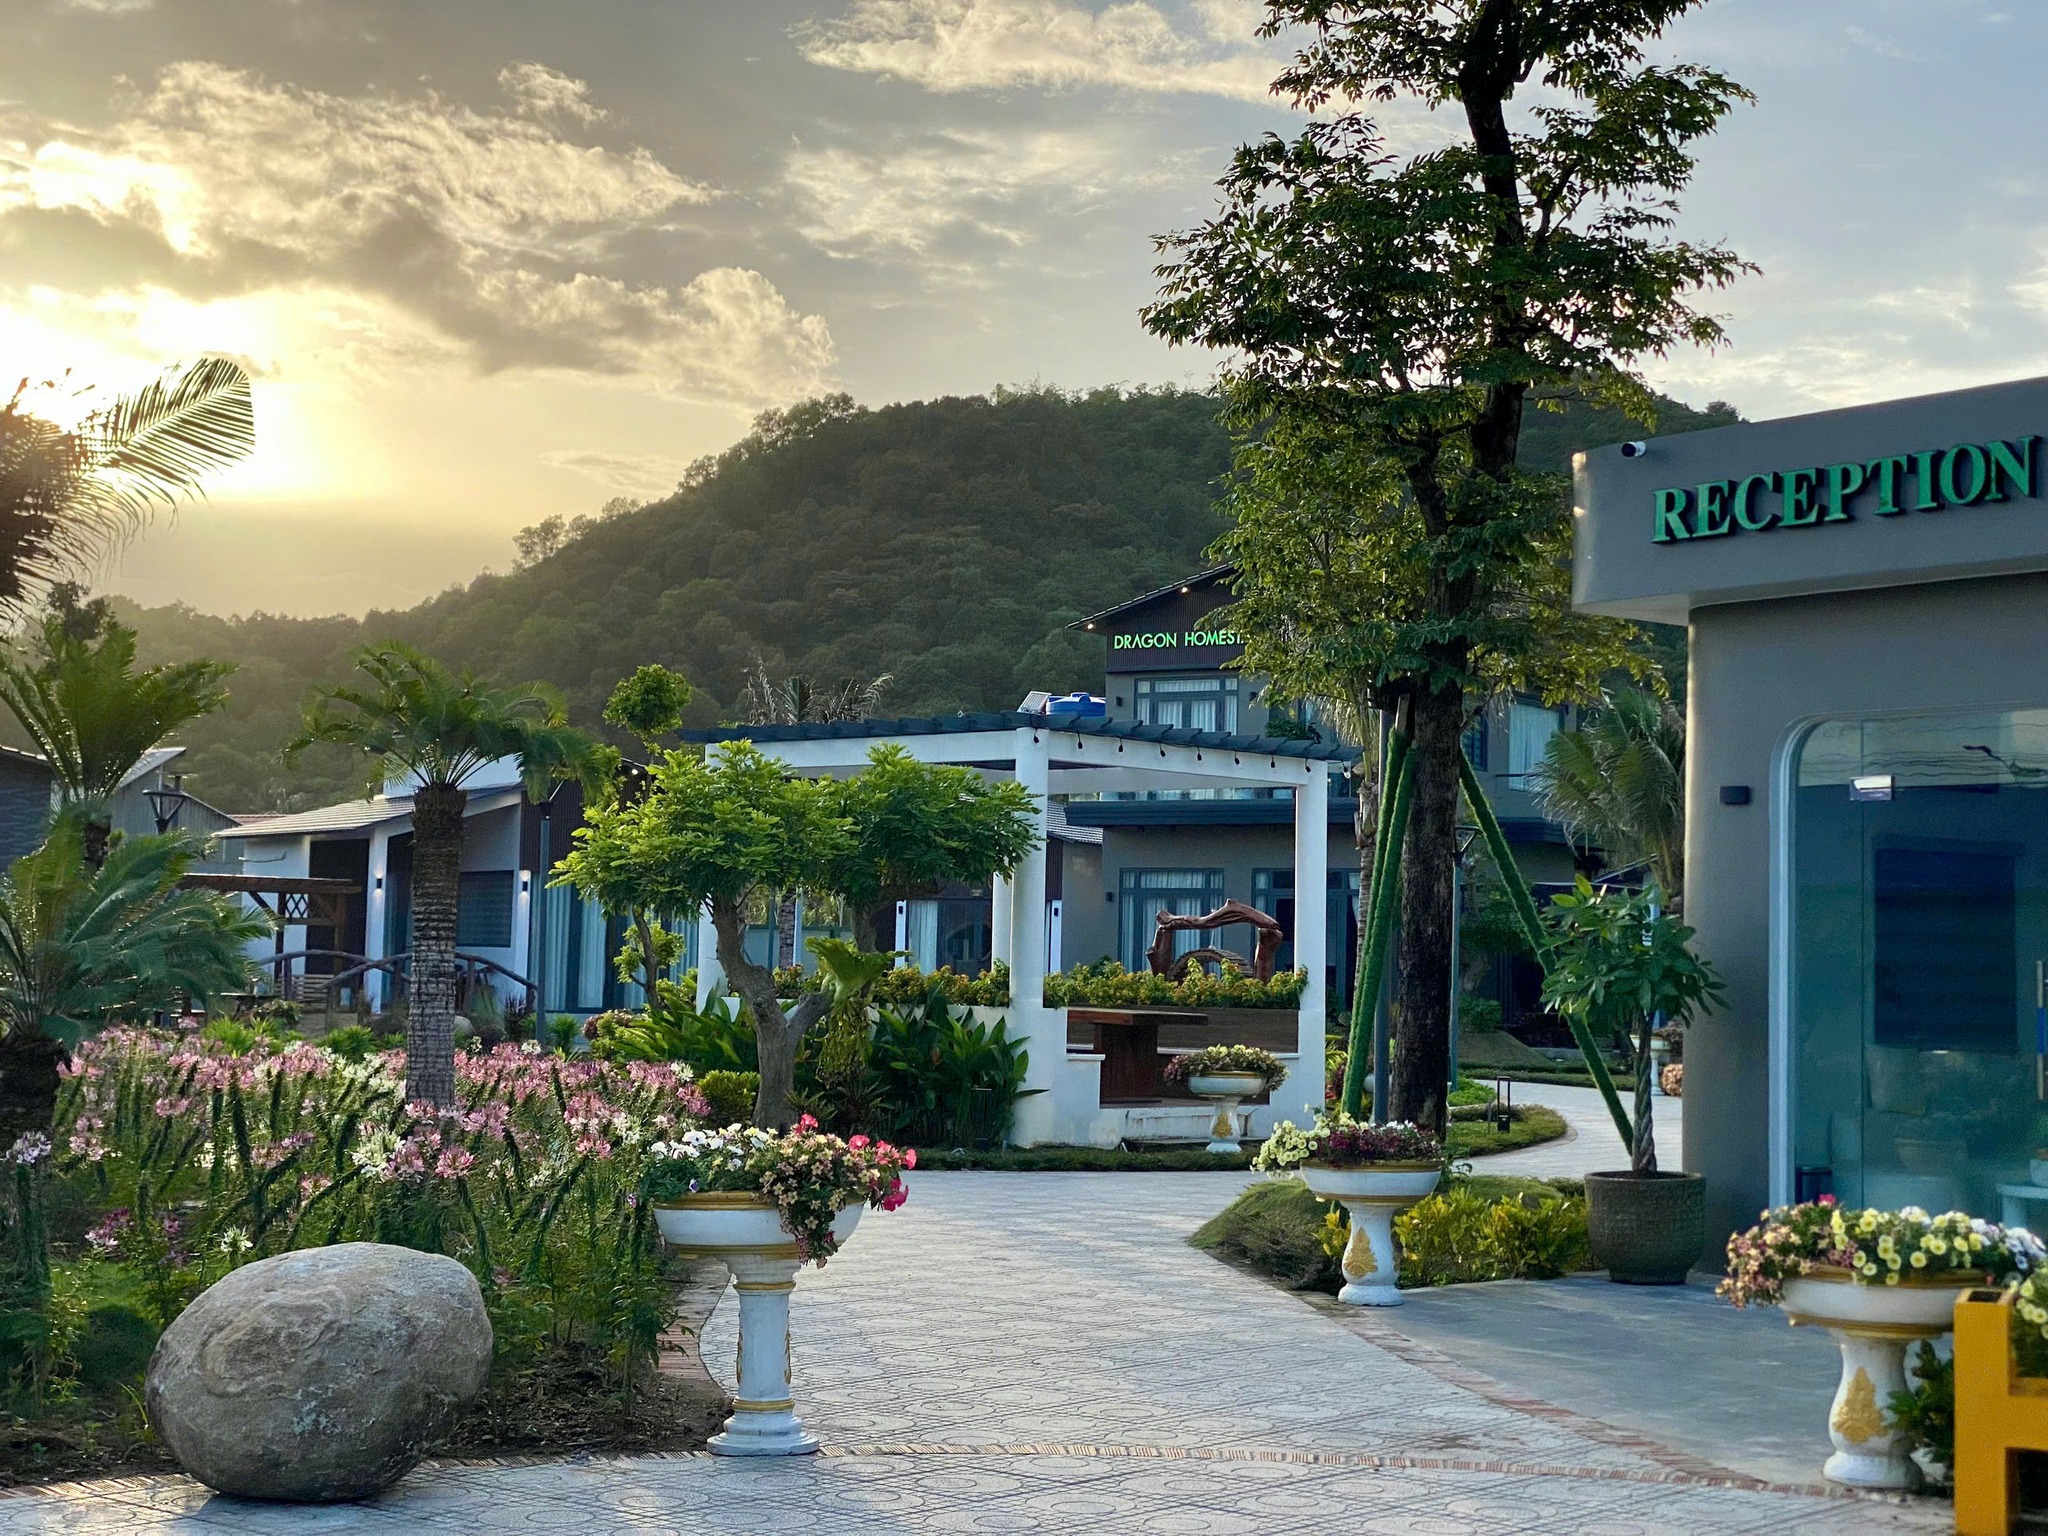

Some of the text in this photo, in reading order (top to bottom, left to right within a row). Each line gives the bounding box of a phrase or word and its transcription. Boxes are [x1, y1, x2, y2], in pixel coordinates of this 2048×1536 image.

[1651, 435, 2040, 544] RECEPTION
[1114, 630, 1244, 649] DRAGON HOMEST
